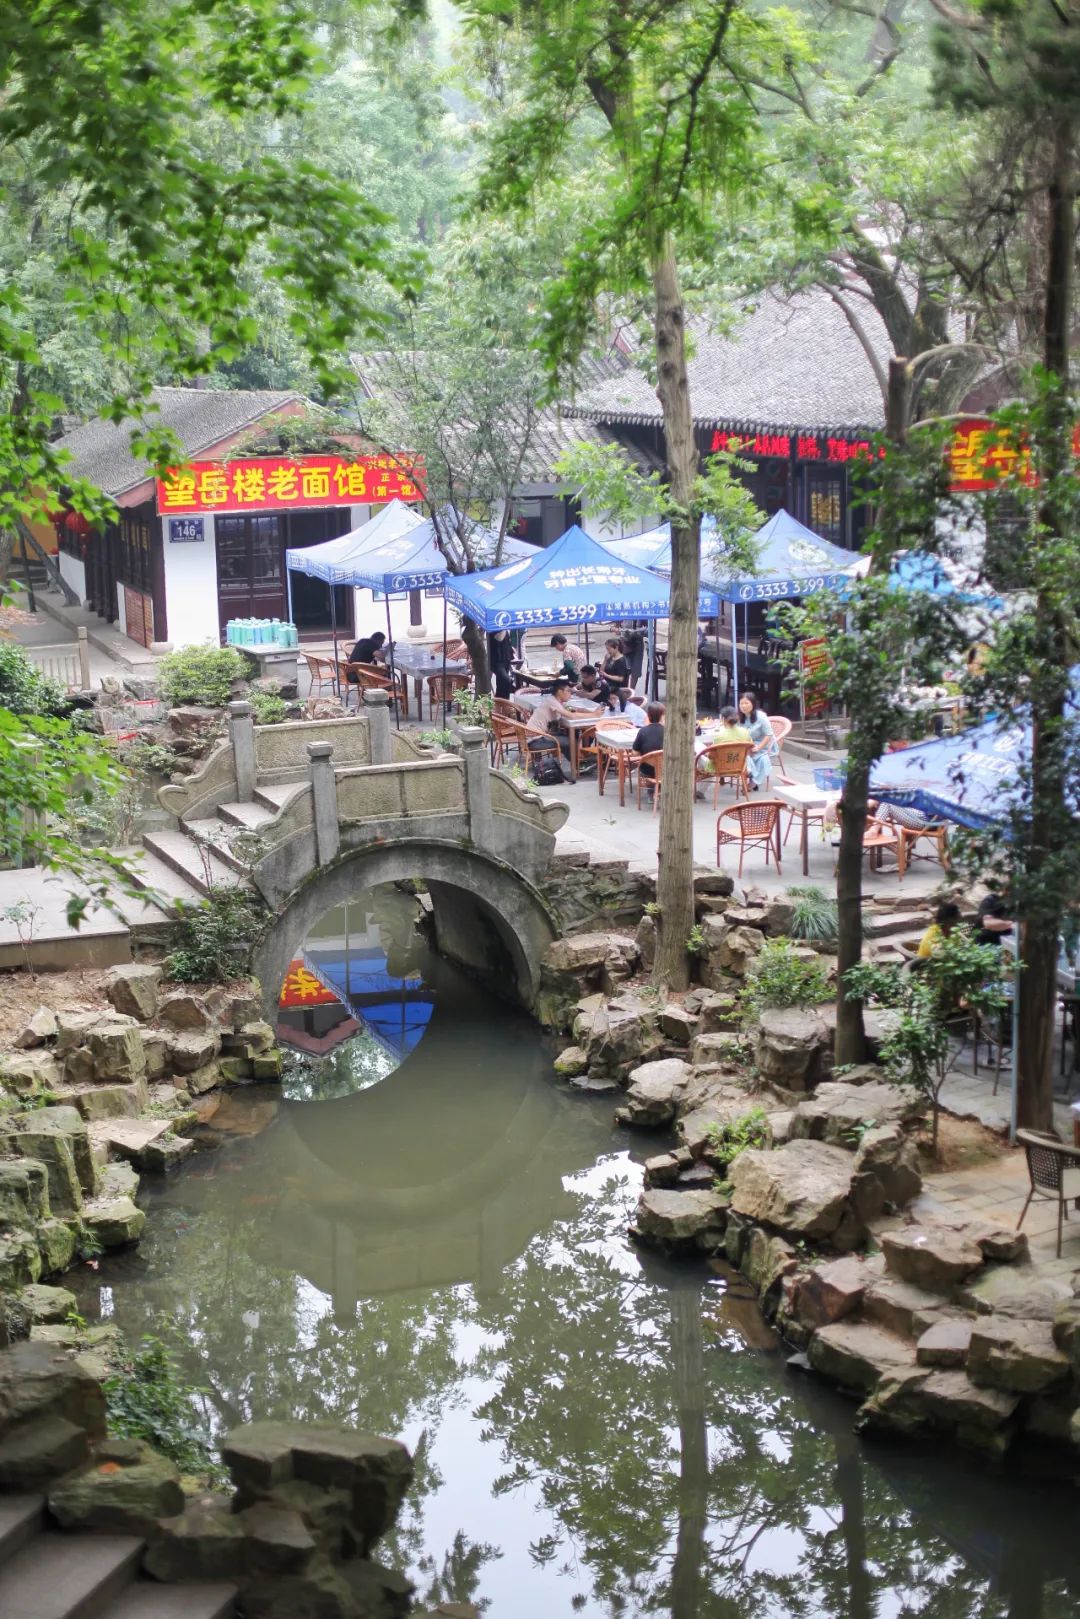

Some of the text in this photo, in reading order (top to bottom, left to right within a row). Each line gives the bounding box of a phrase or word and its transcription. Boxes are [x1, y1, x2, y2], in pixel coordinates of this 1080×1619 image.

[164, 462, 366, 506] 望岳楼老面馆
[177, 524, 196, 537] 146
[408, 574, 443, 588] 3333
[755, 581, 789, 598] 3333
[513, 603, 597, 625] 3333 3399
